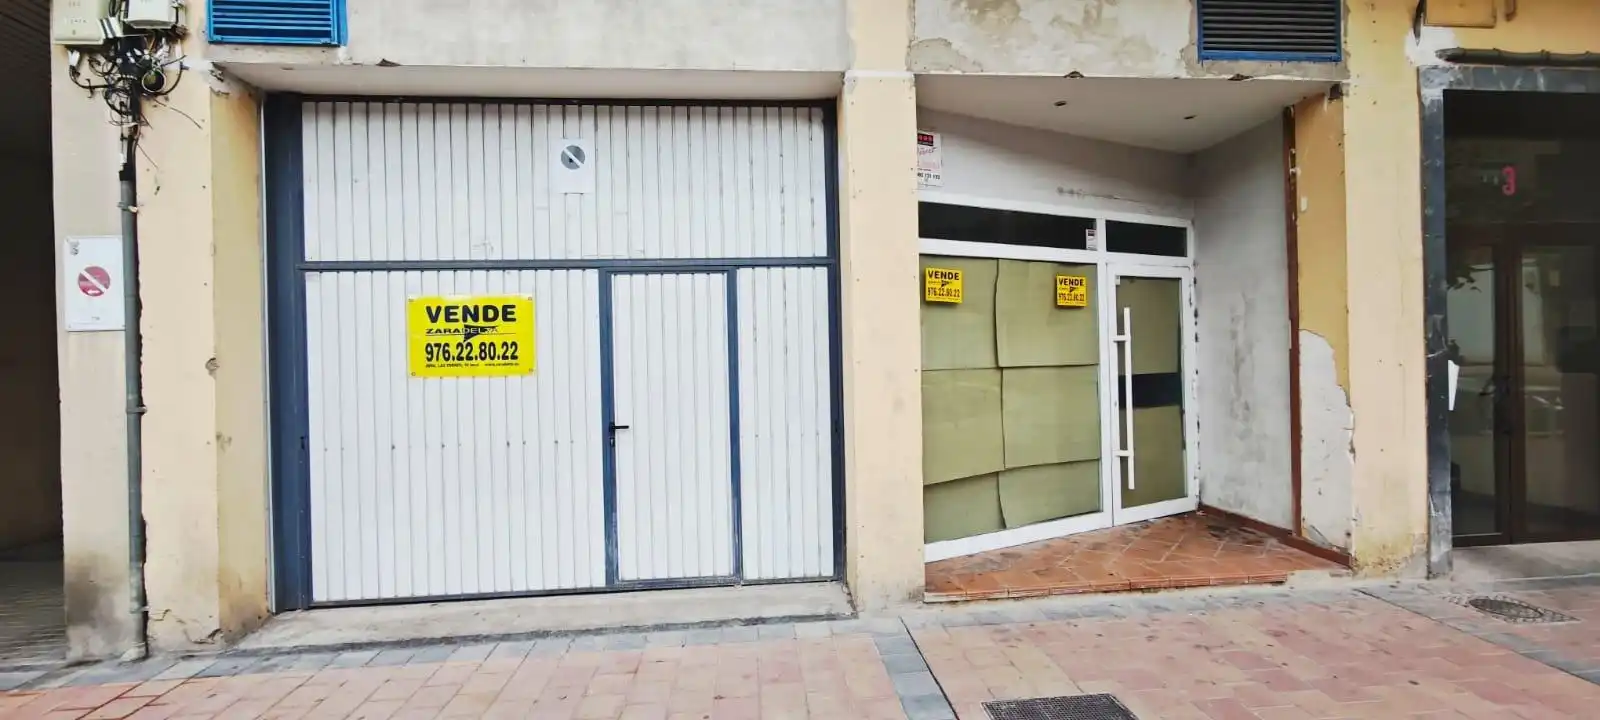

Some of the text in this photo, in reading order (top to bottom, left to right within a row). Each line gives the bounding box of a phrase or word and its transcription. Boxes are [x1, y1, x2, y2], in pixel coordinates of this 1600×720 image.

[1502, 166, 1515, 196] 3
[928, 271, 960, 280] VENDE
[425, 305, 517, 323] VENDE
[425, 341, 519, 361] 976.22.80.22
